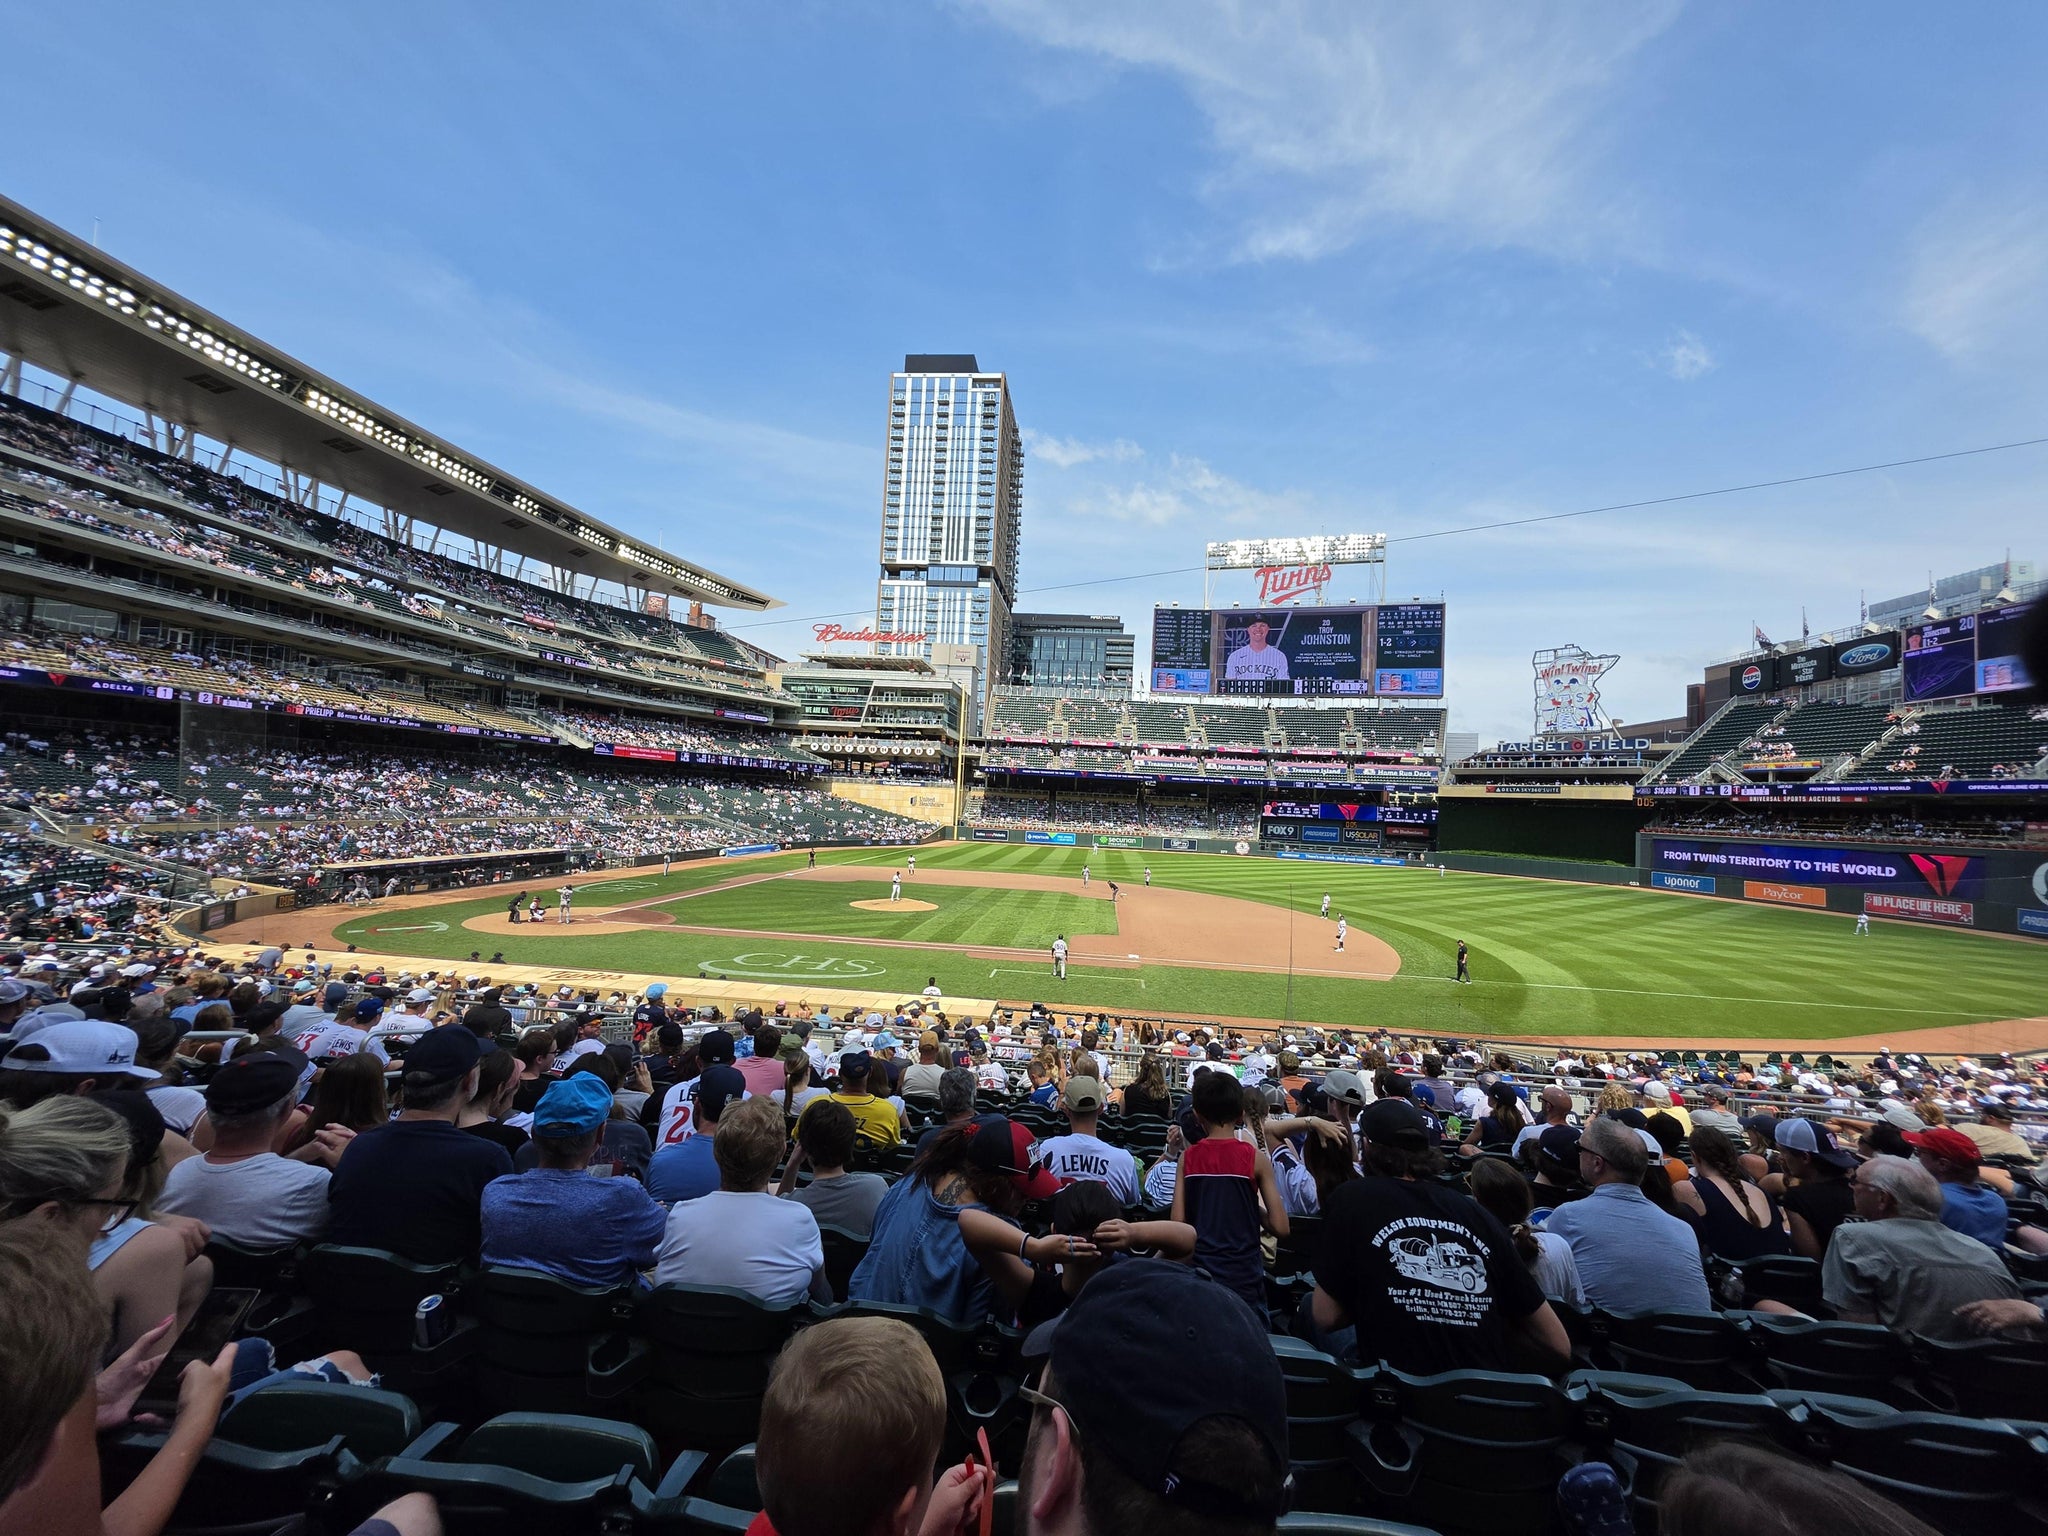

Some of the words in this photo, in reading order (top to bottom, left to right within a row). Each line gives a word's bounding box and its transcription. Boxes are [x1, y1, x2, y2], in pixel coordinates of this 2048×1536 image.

[1255, 562, 1331, 600] Twins
[1959, 617, 1974, 631] 20
[813, 624, 927, 642] Budweiser
[1301, 634, 1351, 645] JOHNSTON
[1380, 638, 1392, 647] 1-2
[1849, 649, 1880, 664] Ford
[1235, 665, 1279, 678] ROCKIES
[1541, 664, 1565, 678] Win!
[1566, 662, 1604, 674] Twins!
[1791, 660, 1818, 670] Minnesota
[464, 666, 484, 676] thrivent
[486, 671, 505, 680] CLUB
[1744, 674, 1760, 682] PEPSI
[1795, 674, 1814, 683] Tribune
[102, 684, 134, 692] DELTA
[203, 694, 209, 702] 2
[305, 707, 334, 717] PRIELIPP
[1499, 741, 1569, 752] TARGET
[1589, 739, 1650, 750] FIELD
[1268, 826, 1287, 835] FOX
[1288, 827, 1294, 836] 9
[1664, 850, 1692, 861] FROM
[1693, 852, 1727, 864] TWINS
[1729, 855, 1792, 870] TERRITORY
[1793, 860, 1811, 871] TO
[1814, 862, 1841, 874] THE
[1842, 864, 1897, 878] WORLD
[1664, 877, 1700, 889] uponor
[1763, 887, 1804, 901] Paycor
[1873, 896, 1882, 907] NO
[1883, 896, 1915, 911] PLACE
[1917, 900, 1932, 912] LIKE
[1934, 900, 1962, 916] HERE
[733, 953, 875, 973] CHS
[541, 970, 624, 980] Twins
[332, 1039, 354, 1051] LEWIS
[1061, 1154, 1110, 1176] LEWIS
[1372, 1219, 1407, 1248] WELSH
[1405, 1217, 1472, 1239] EQUIPMENT
[1472, 1235, 1491, 1259] INC.
[1388, 1287, 1407, 1296] Your
[1409, 1288, 1421, 1296] #1
[1424, 1289, 1442, 1298] Used
[1444, 1292, 1470, 1303] Truck
[1470, 1294, 1493, 1303] Source
[1406, 1305, 1429, 1314] Griffin,
[1437, 1300, 1448, 1308] MN
